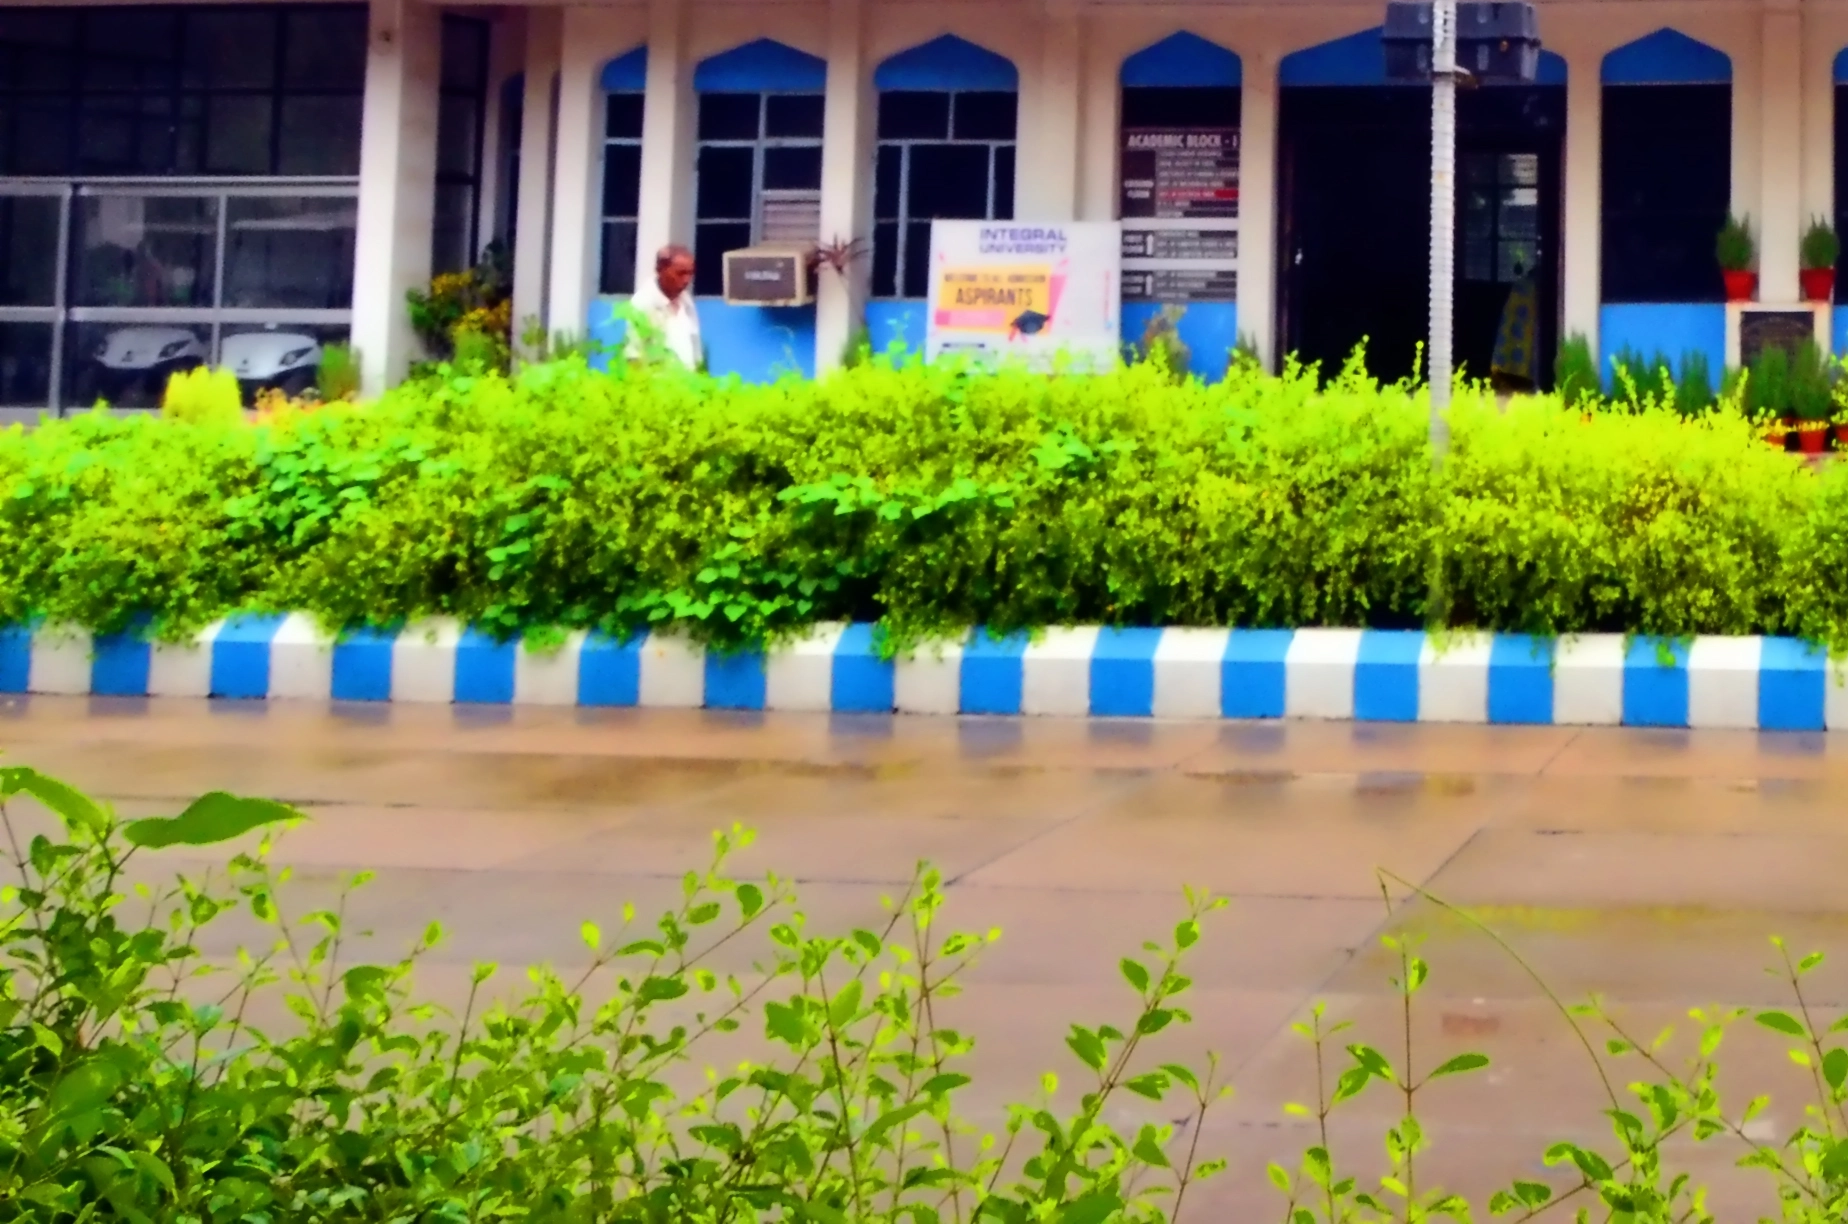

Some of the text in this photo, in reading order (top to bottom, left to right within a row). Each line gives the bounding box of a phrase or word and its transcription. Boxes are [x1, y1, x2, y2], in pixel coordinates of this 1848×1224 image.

[1127, 134, 1184, 148] ACADEMIC
[1186, 134, 1222, 148] BLOCK
[979, 228, 1068, 241] INTEGRAL
[978, 243, 1067, 254] UNIVERSITY
[955, 287, 1033, 307] ASPIRANTS
